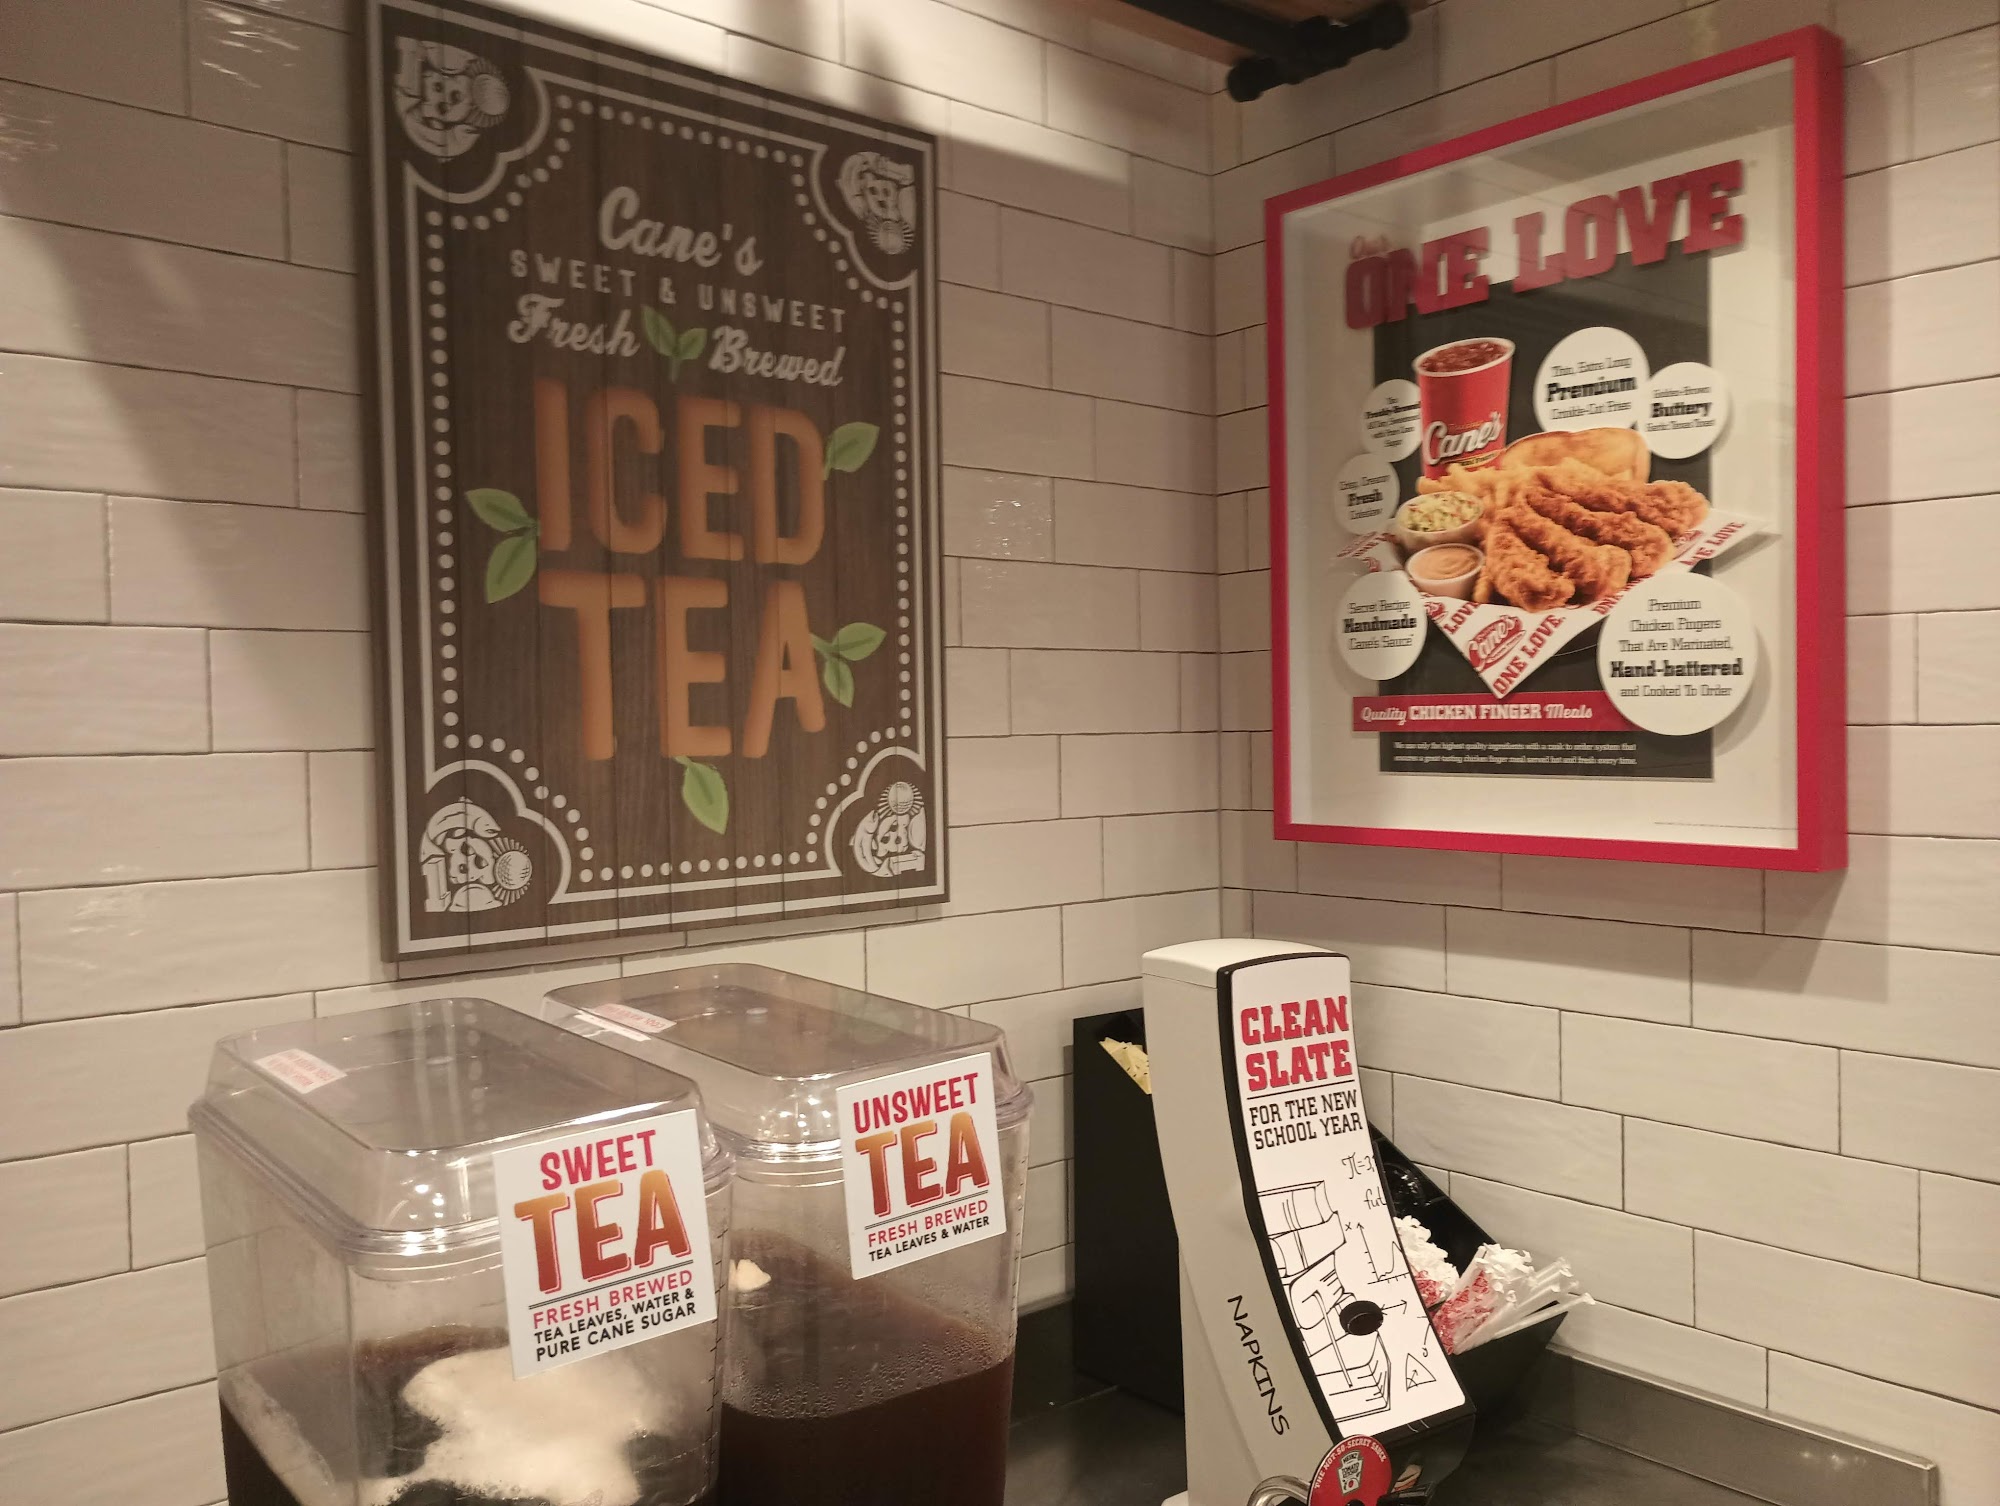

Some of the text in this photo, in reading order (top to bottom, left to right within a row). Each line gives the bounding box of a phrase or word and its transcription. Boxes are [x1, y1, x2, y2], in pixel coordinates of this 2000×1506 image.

[600, 185, 764, 276] Cane's
[1345, 158, 1744, 331] ONE LOVE
[510, 248, 846, 334] SWEET & UNSWEET
[507, 293, 847, 387] Fresh Brewed
[1605, 356, 1633, 370] Long
[1546, 376, 1638, 403] Premium
[1651, 401, 1712, 418] Buttery
[1424, 411, 1503, 465] Cane's
[533, 377, 826, 566] ICED
[1347, 488, 1383, 507] Fresh
[1343, 613, 1417, 634] Handmade
[1349, 602, 1377, 615] Secret
[1379, 599, 1411, 613] Recipe
[1630, 617, 1722, 633] Chicken Fingers
[1648, 598, 1702, 612] Premium
[538, 570, 826, 762] TEA
[1349, 635, 1379, 650] Cane's
[1619, 636, 1734, 652] That Are Marinated,
[1492, 655, 1529, 695] ONE
[1610, 657, 1744, 678] Hand-battered
[1620, 684, 1733, 697] and Cooked To Order
[1361, 703, 1593, 726] Quality CHICKEN FINGER Meals
[1240, 995, 1350, 1046] CLEAN
[1245, 1039, 1353, 1092] SLATE
[853, 1072, 979, 1134] UNSWEET
[1249, 1089, 1358, 1127] FOR THE NEW
[1253, 1112, 1364, 1150] SCHOOL YEAR
[540, 1129, 657, 1191] SWEET
[855, 1112, 991, 1217] TEA
[513, 1169, 693, 1295] TEA
[867, 1200, 988, 1247] FRESH BREWED
[868, 1216, 990, 1262] TEA LEAVES & WATER
[533, 1270, 693, 1329] FRESH BREWED
[534, 1287, 695, 1344] TEA LEAVES, WATER &
[536, 1302, 697, 1362] PURE CANE SUGAR
[1227, 1295, 1290, 1436] NAPKINS
[1314, 1438, 1388, 1489] THE NOT-SO-SECRET SAUCE
